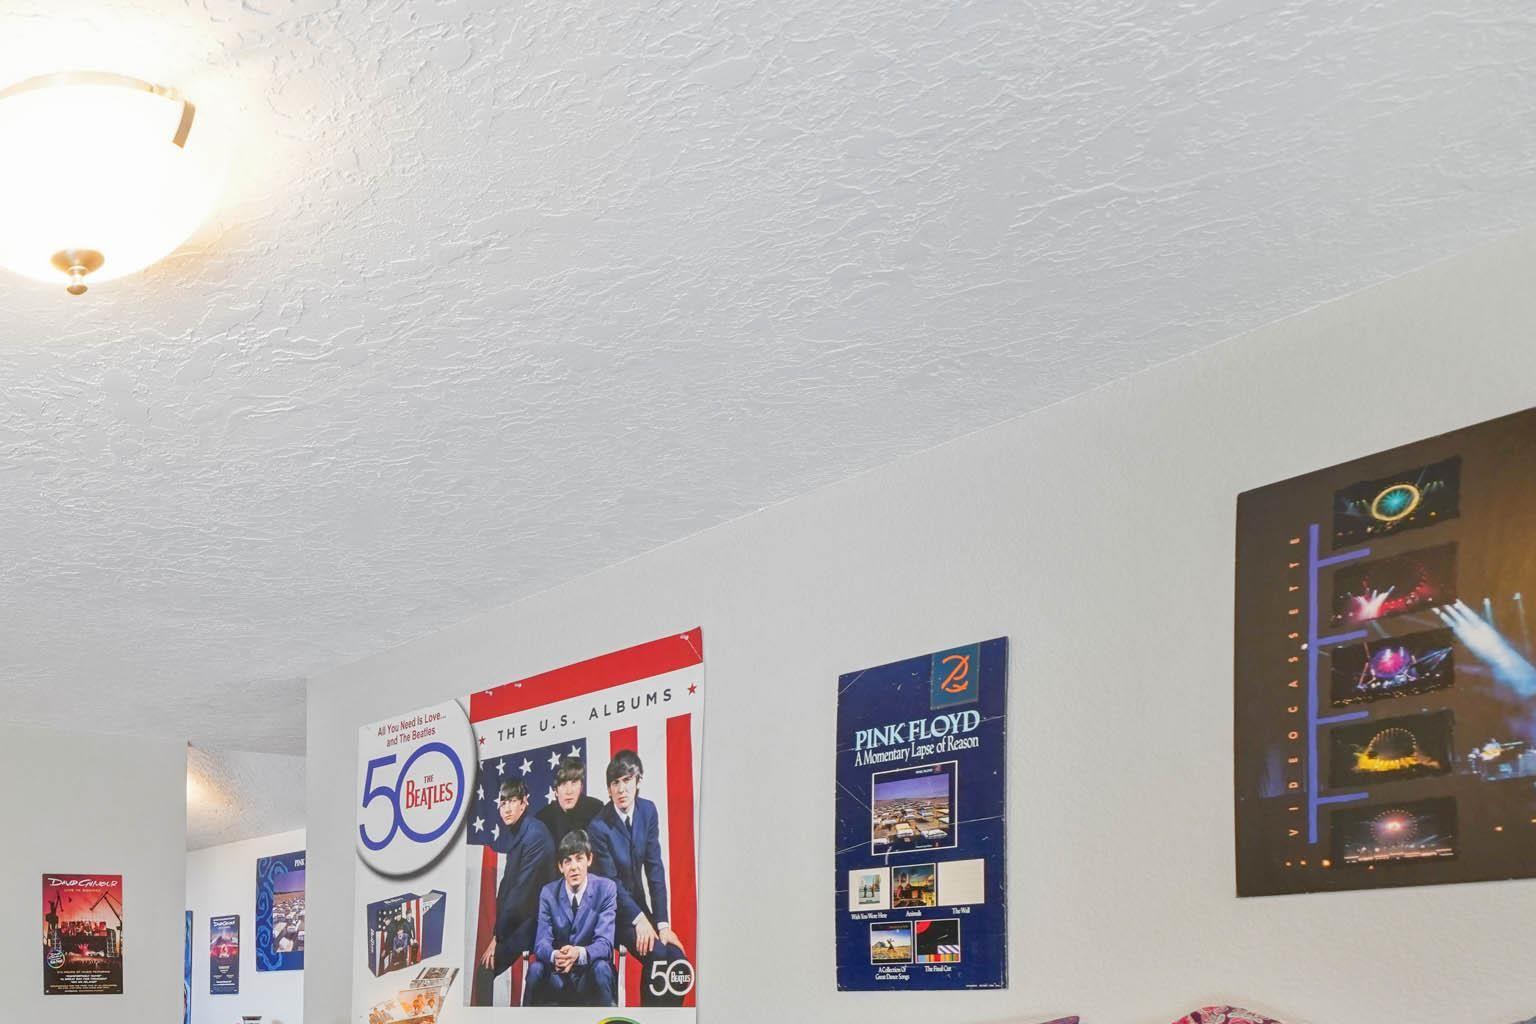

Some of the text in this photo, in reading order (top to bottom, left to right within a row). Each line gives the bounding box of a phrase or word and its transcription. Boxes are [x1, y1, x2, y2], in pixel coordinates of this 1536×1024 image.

[377, 726, 386, 736] All
[388, 723, 399, 734] You
[400, 719, 416, 730] Need
[498, 688, 672, 741] THE U.S. ALBUMS
[855, 710, 981, 751] PINK FLOYD
[386, 727, 437, 747] and The Beatles
[855, 735, 980, 767] A Momentary Lapse of Reason
[405, 780, 454, 809] BEATLES
[423, 774, 435, 783] THE
[359, 742, 465, 851] 50
[649, 959, 694, 996] 50
